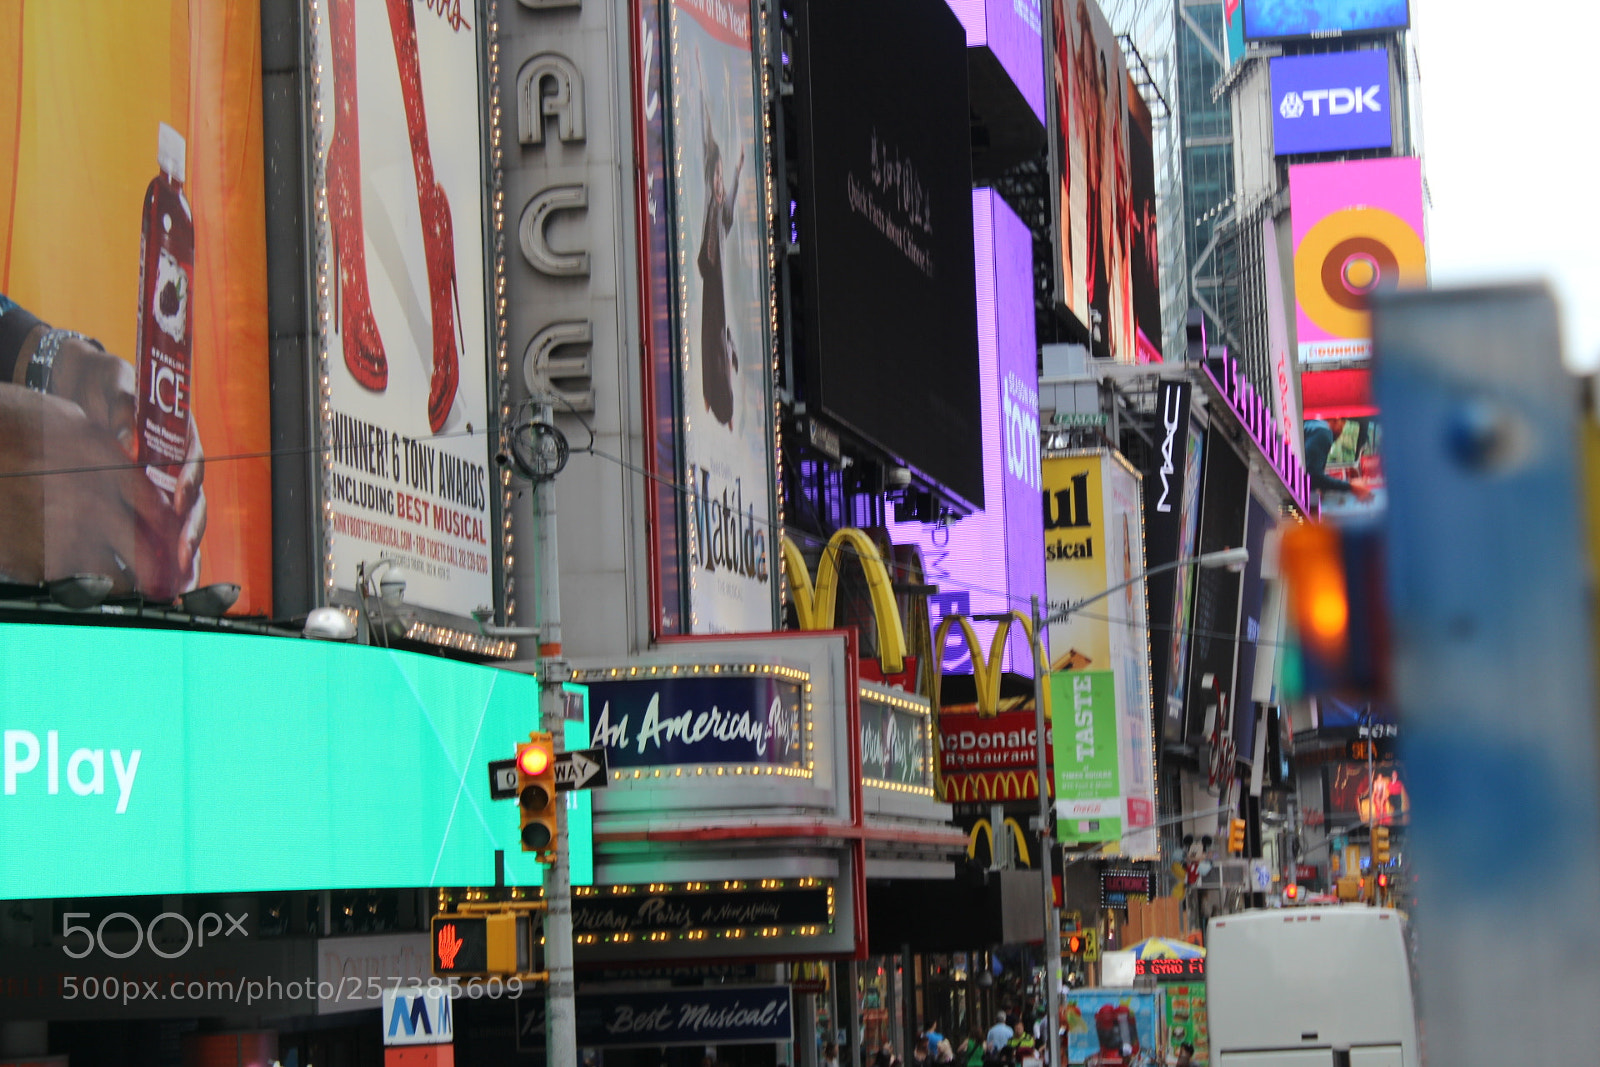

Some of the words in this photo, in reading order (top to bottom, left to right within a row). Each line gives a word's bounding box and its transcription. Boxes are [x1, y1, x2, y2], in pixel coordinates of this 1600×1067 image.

[1311, 28, 1342, 39] TOSHIBA
[1303, 84, 1381, 116] TDK
[149, 359, 185, 419] ICE
[331, 411, 389, 481] WINNER!
[392, 432, 400, 483] 6
[403, 436, 434, 495] TONY
[439, 451, 486, 513] AWARDS
[333, 472, 395, 516] INCLUDING
[397, 491, 430, 527] BEST
[433, 505, 487, 545] MUSICAL
[689, 463, 769, 585] Matilda
[590, 700, 629, 748] An
[636, 692, 767, 756] American
[1073, 675, 1095, 763] TASTE
[3, 729, 143, 814] Play
[555, 762, 588, 783] WAY
[945, 748, 1035, 766] Restaurant
[606, 1003, 675, 1034] Best
[678, 998, 788, 1032] Musical!
